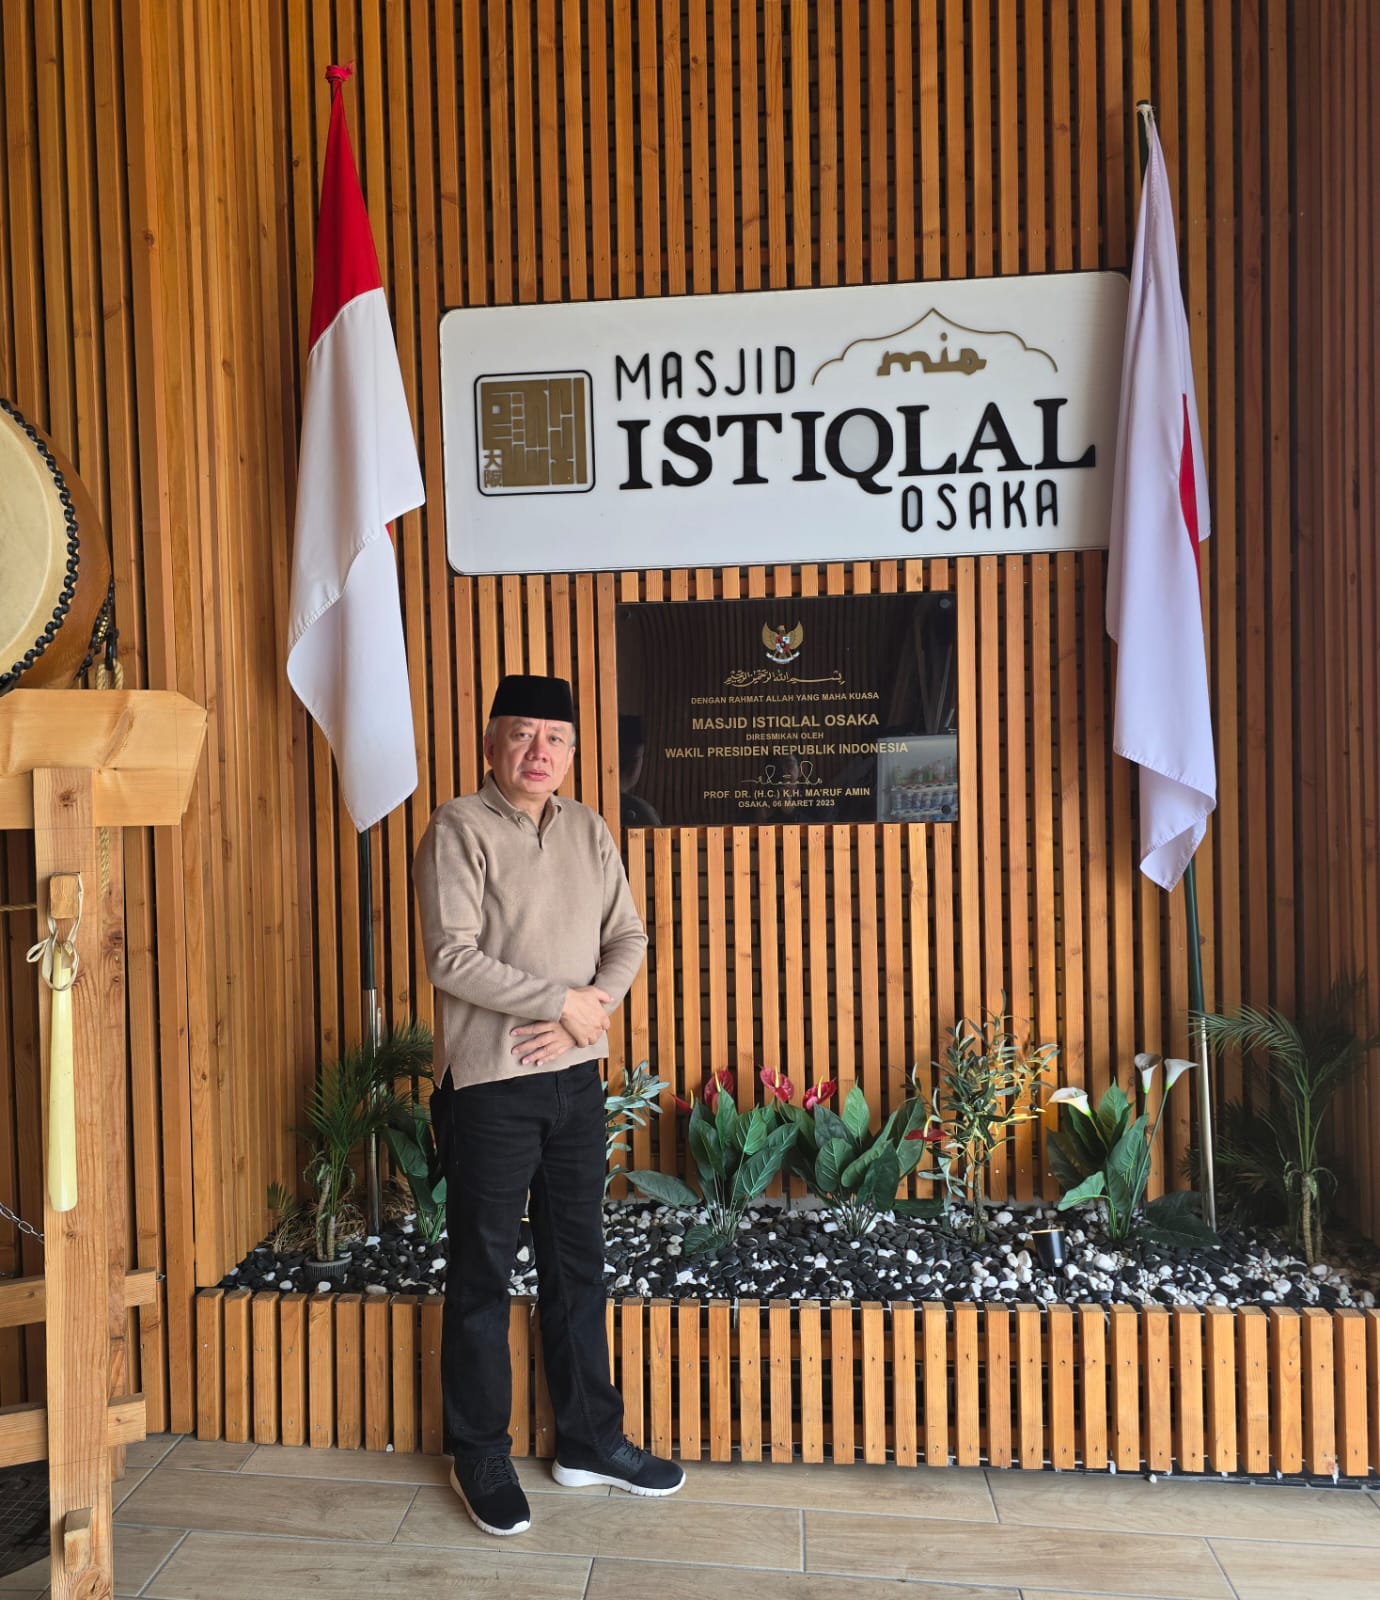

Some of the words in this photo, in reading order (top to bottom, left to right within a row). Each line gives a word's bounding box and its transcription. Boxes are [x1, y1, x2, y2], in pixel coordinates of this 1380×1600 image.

[615, 345, 796, 401] MASJID
[618, 398, 1096, 495] ISTIQLAL
[901, 479, 1059, 533] OSAKA
[690, 696, 727, 706] DENGAN
[728, 695, 765, 704] RAHMAT
[766, 694, 795, 703] ALLAH
[796, 693, 820, 702] YANG
[821, 692, 848, 701] MAHA
[849, 691, 880, 701] KUASA
[692, 717, 748, 730] MASJID
[752, 715, 821, 729] ISTIQLAL
[824, 713, 880, 727] OSAKA
[745, 732, 799, 741] DIRESMIKAN
[800, 731, 825, 740] OLEH
[664, 747, 705, 759] WAKIL
[707, 745, 769, 758] PRESIDEN
[772, 743, 836, 756] REPUBLIK
[838, 741, 909, 754] INDONESIA
[734, 790, 752, 799] DR.
[753, 789, 781, 801] (H.C.)
[804, 787, 843, 797] MA'RUF
[844, 787, 871, 796] AMIN
[738, 800, 771, 810] OSAKA,
[784, 799, 814, 808] MARET
[815, 798, 836, 807] 2023
